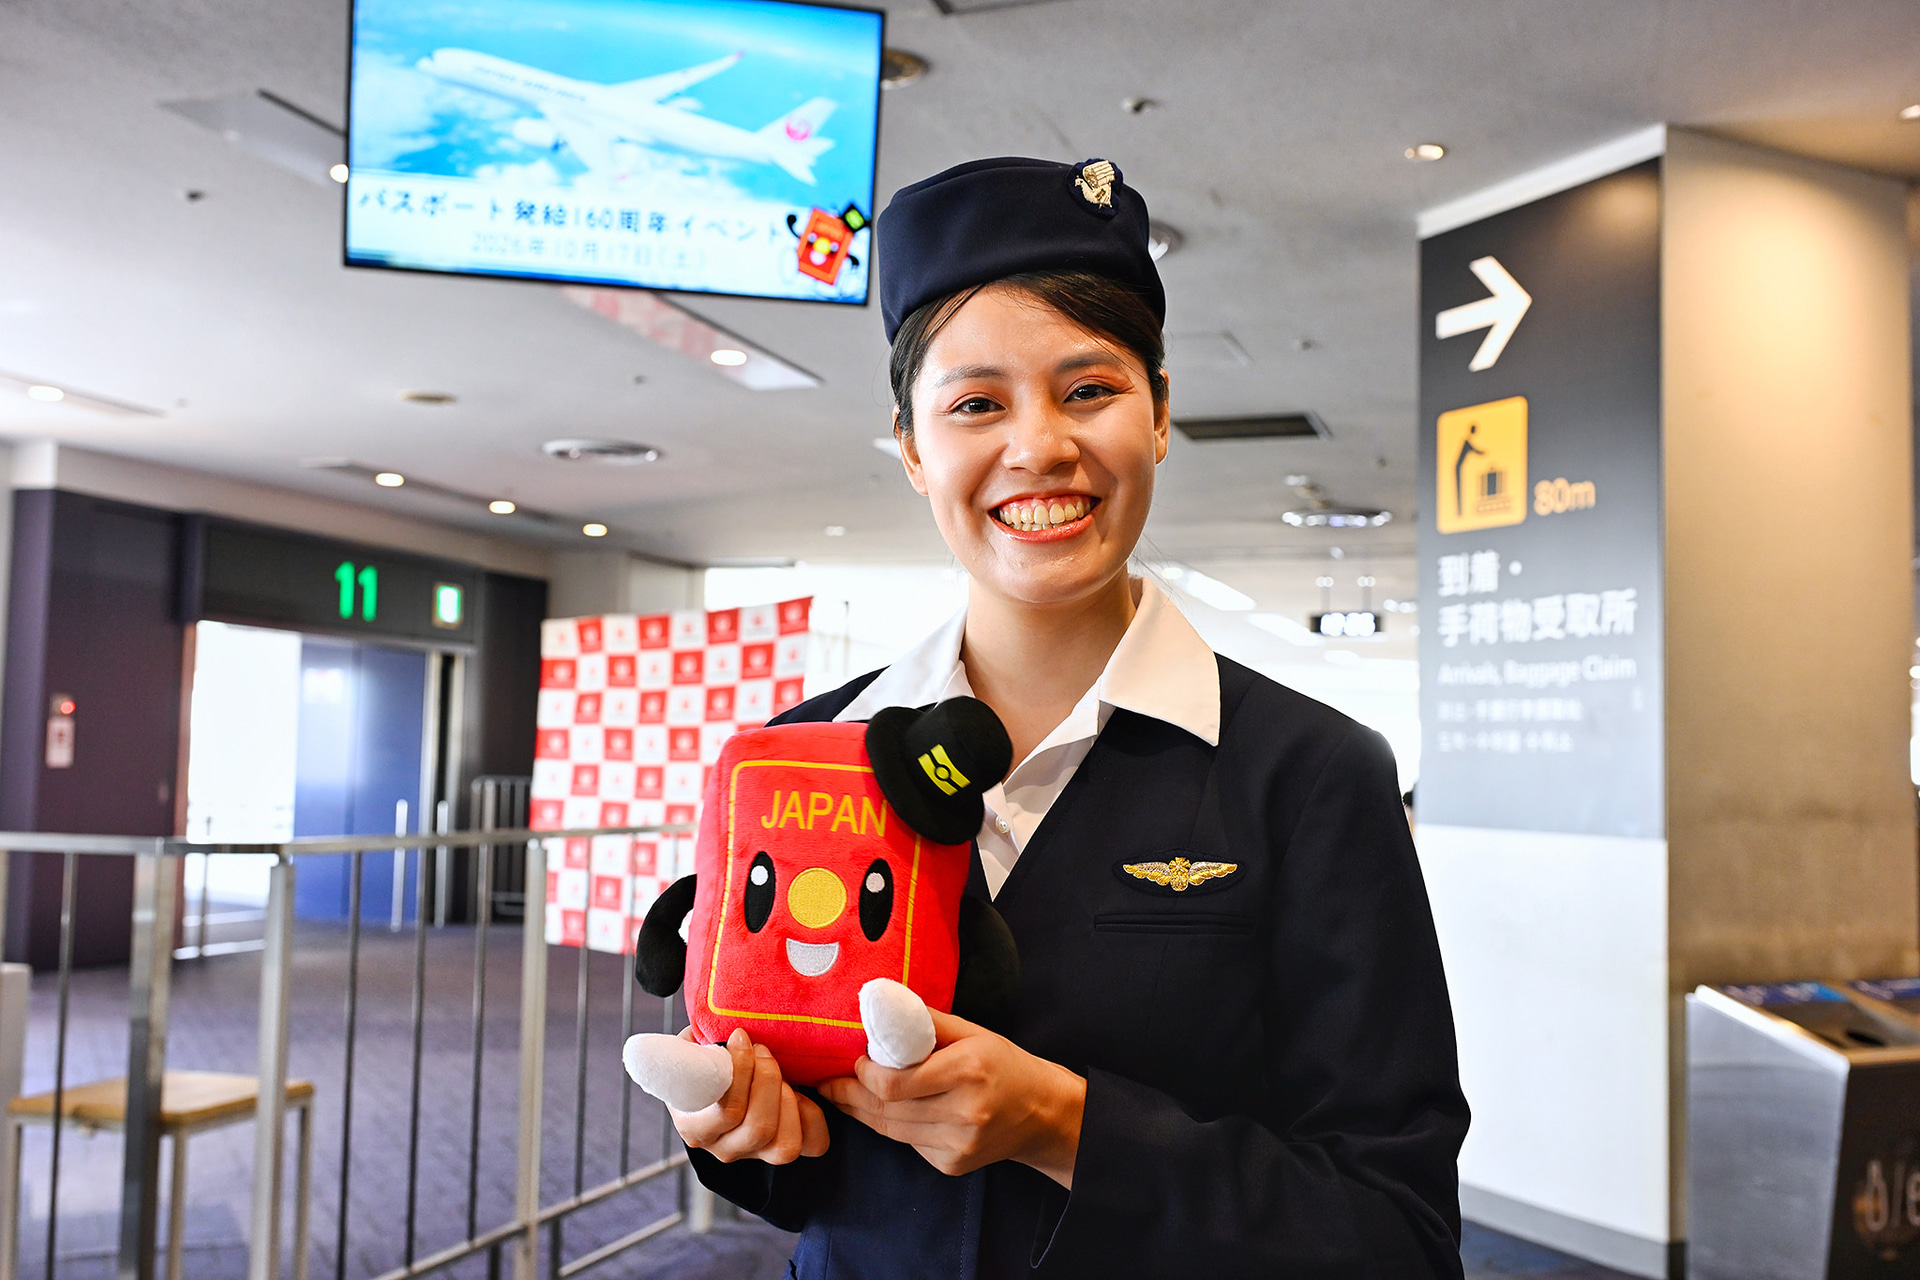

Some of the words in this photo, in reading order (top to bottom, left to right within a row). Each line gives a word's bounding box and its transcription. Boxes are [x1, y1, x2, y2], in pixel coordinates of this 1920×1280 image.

[1533, 477, 1597, 516] 80m
[334, 560, 378, 622] 11
[1438, 588, 1638, 647] 手荷物受取所
[1503, 658, 1581, 689] Baggage
[1582, 654, 1638, 681] Claim
[760, 789, 888, 838] JAPAN
